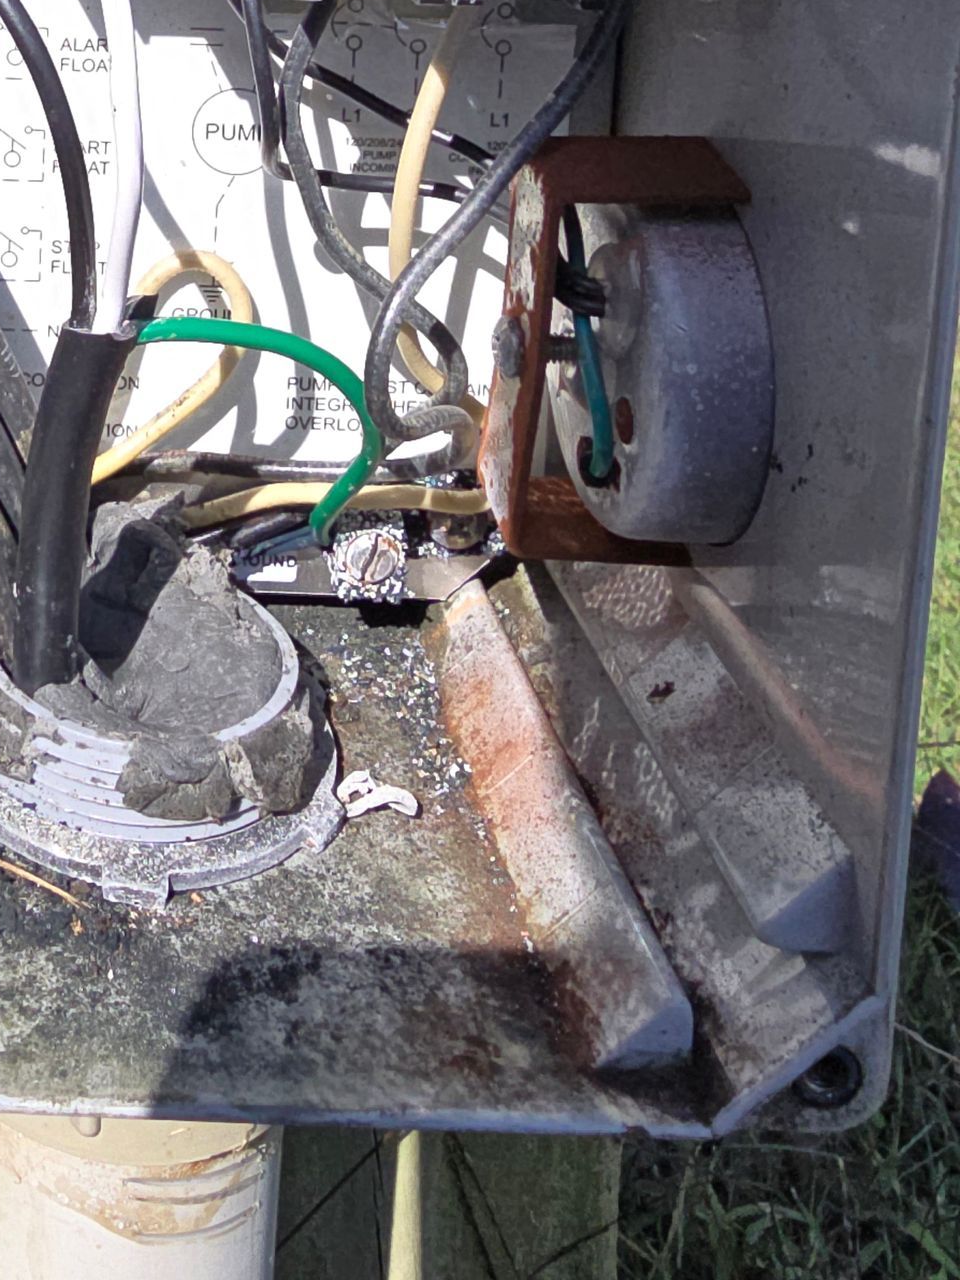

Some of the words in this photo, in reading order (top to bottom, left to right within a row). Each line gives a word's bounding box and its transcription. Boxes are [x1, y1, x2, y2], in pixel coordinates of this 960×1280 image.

[60, 37, 109, 53] ALAR
[60, 57, 111, 73] FLOA
[342, 108, 361, 123] L1
[490, 112, 510, 128] L1
[350, 162, 398, 173] INCOMIN
[286, 396, 355, 412] INTEGR
[285, 415, 363, 433] OVERLO
